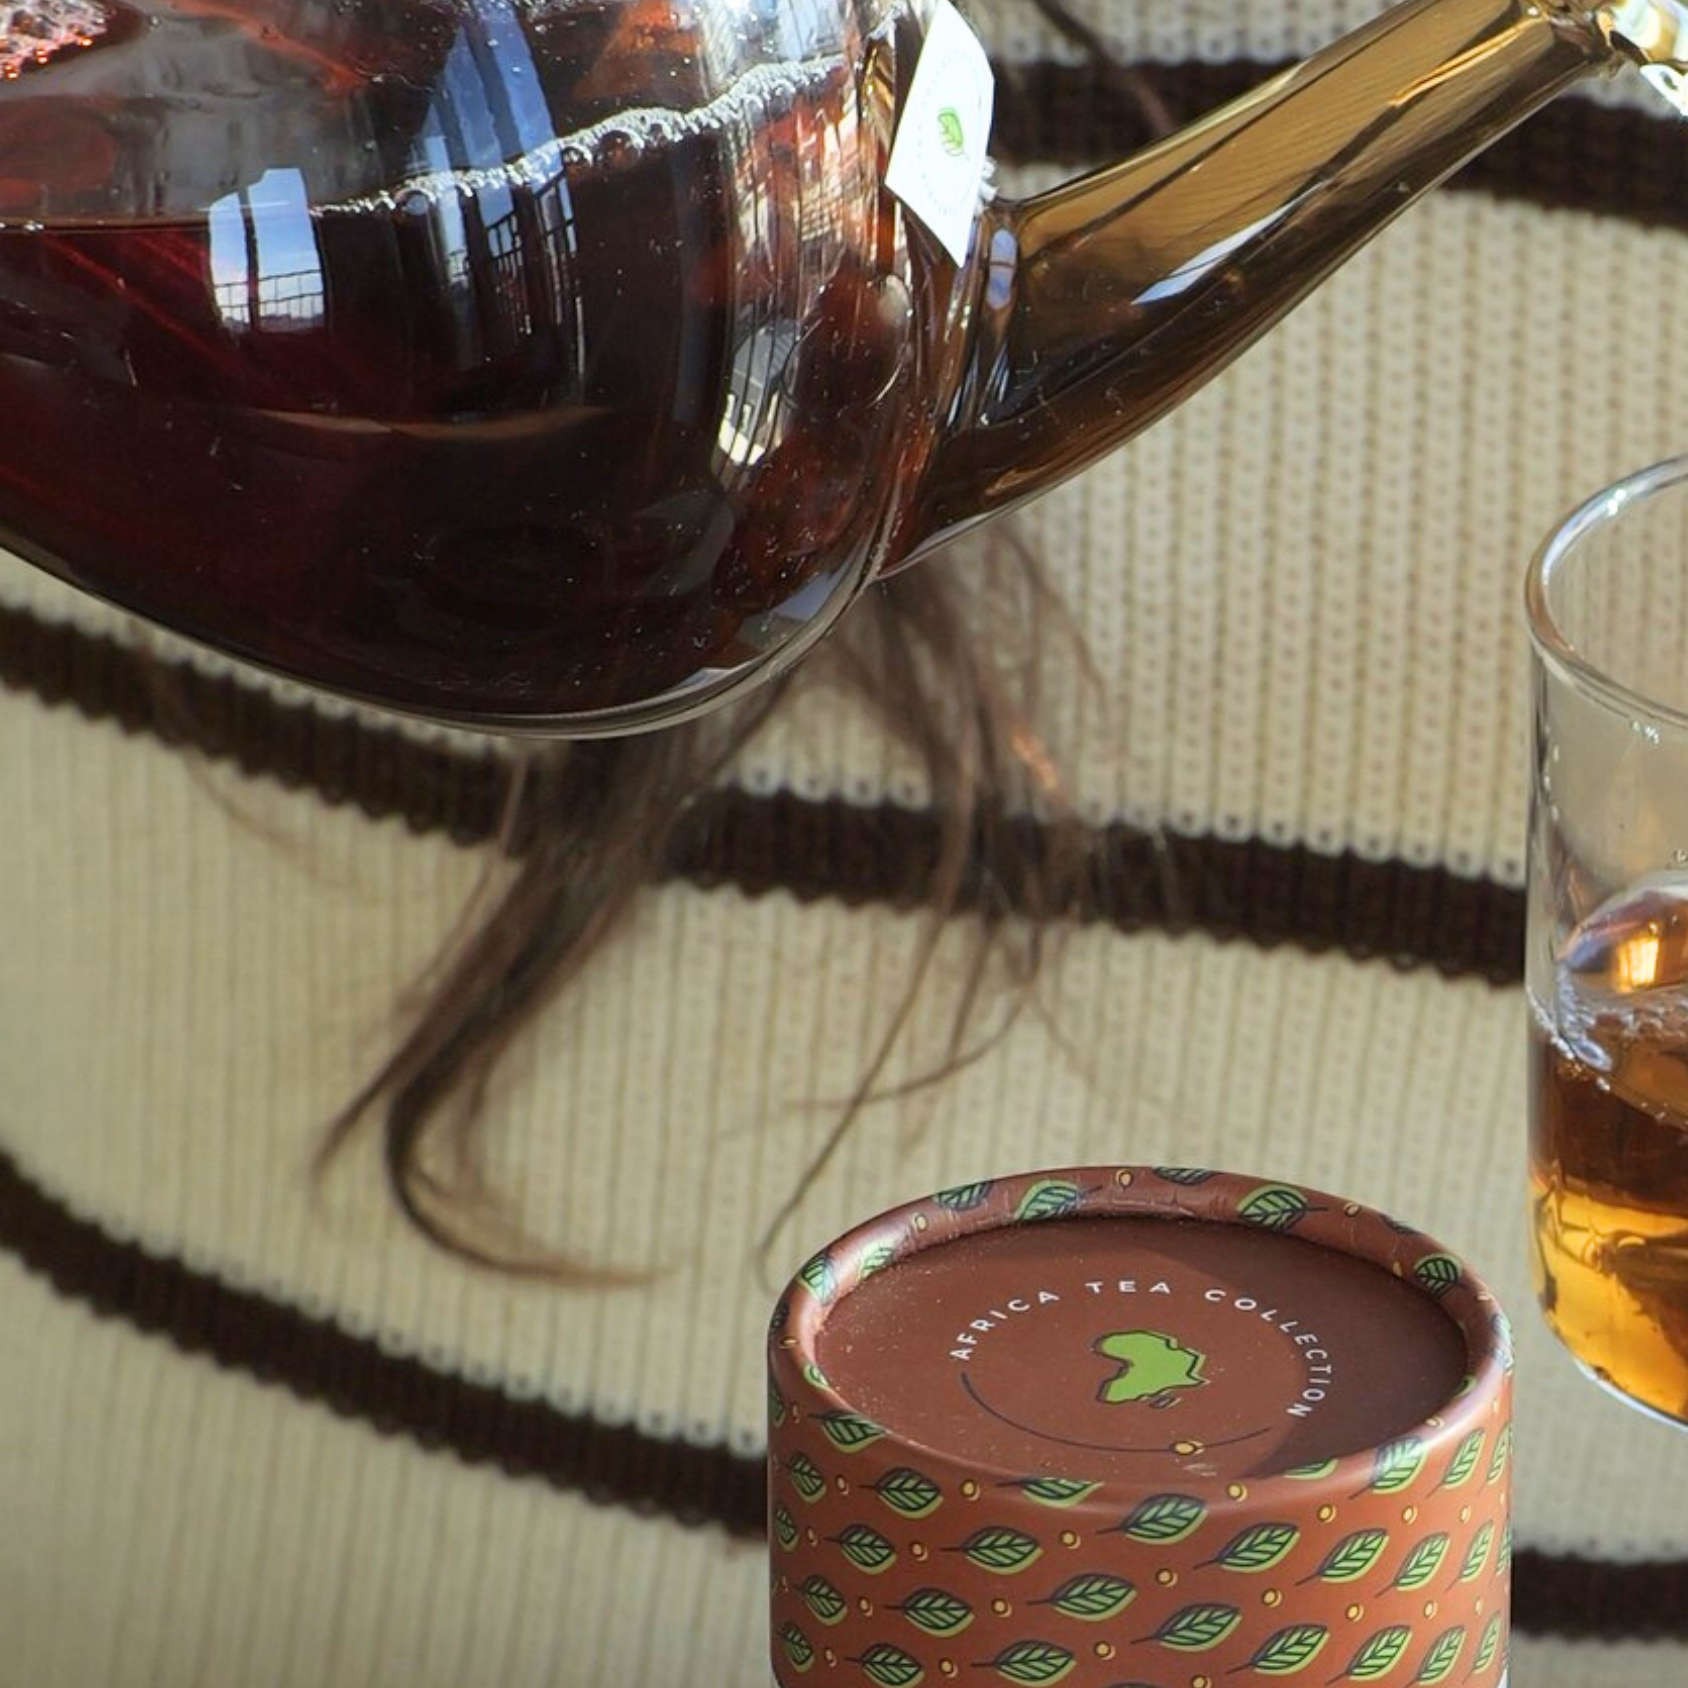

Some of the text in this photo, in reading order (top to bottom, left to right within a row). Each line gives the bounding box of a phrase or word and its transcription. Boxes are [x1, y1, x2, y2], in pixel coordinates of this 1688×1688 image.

[950, 1279, 1331, 1418] AFRICA TEA COLLECTION
